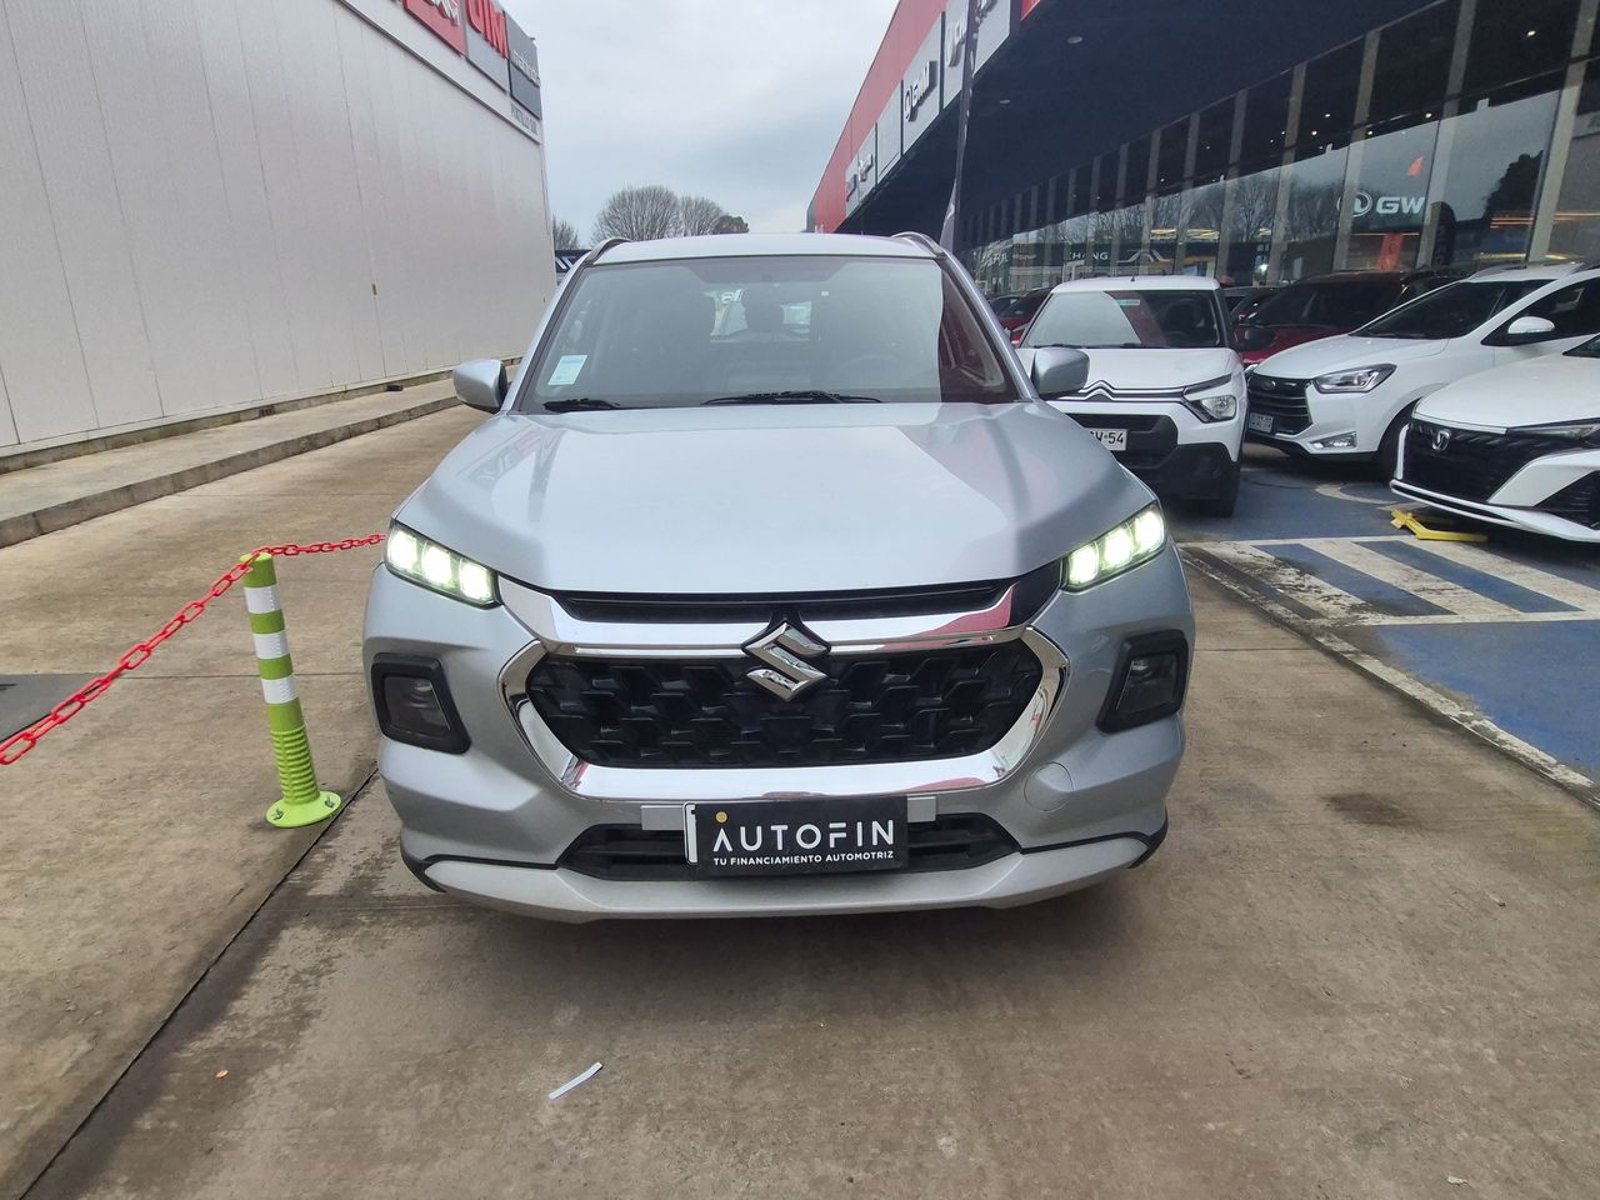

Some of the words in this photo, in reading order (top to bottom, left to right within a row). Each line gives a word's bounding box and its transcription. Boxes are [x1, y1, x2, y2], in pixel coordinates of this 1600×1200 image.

[712, 819, 895, 852] AUTOFIN
[713, 857, 728, 866] TU
[730, 854, 822, 866] FINANCIAMIENTO
[825, 850, 894, 863] AUTOMOTRIZ
